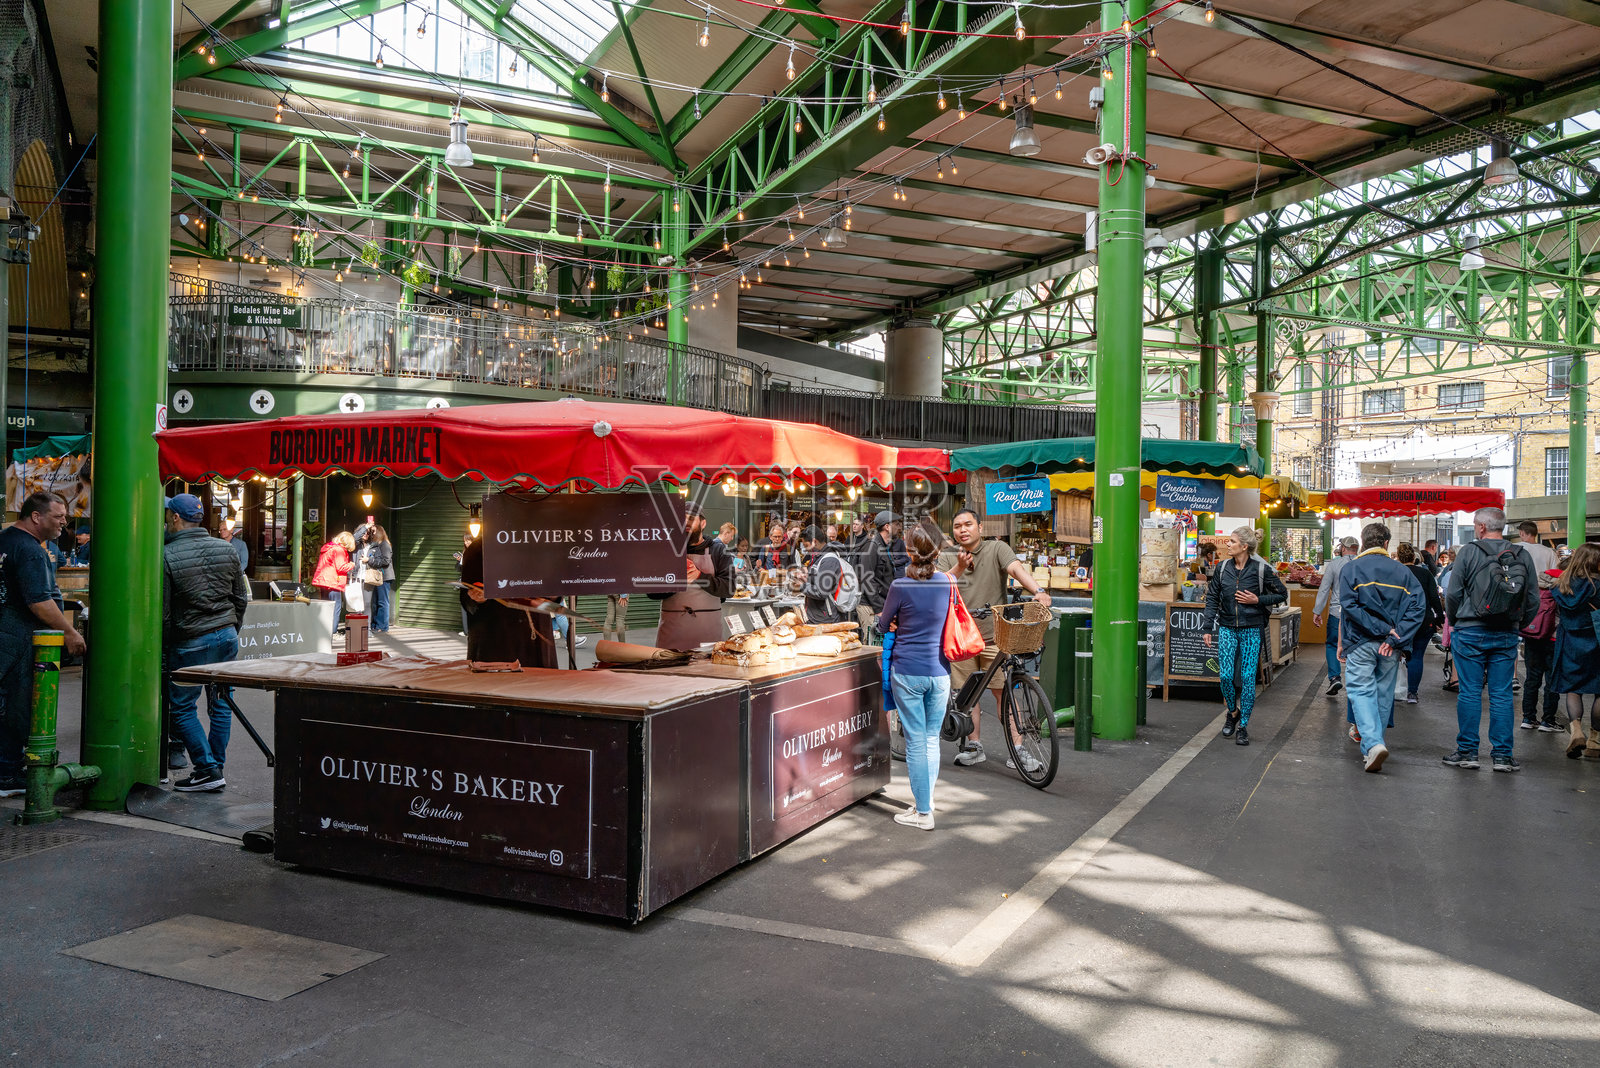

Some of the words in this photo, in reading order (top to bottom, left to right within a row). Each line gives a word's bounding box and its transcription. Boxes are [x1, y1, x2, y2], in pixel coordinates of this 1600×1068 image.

[233, 305, 261, 314] Bedales
[263, 306, 281, 315] Wine
[282, 306, 296, 316] Bar
[246, 315, 253, 324] &
[254, 315, 282, 325] Kitchen
[268, 427, 356, 466] BOROUGH
[358, 426, 443, 465] MARKET
[1160, 481, 1197, 494] Cheddar
[992, 491, 1019, 503] Raw
[1019, 488, 1045, 501] Milk
[1169, 491, 1220, 504] Clothbound
[1379, 490, 1414, 501] BOROUGH
[1415, 490, 1448, 501] MARKET
[1011, 499, 1042, 512] Cheese
[1189, 502, 1213, 510] cheese
[496, 529, 594, 544] OLIVIER'S
[600, 527, 675, 542] BAKERY
[1201, 537, 1230, 547] alpine
[567, 546, 609, 560] London
[560, 577, 616, 585] www.oliviersbakery.com
[1170, 611, 1220, 632] CHEDDR
[264, 632, 304, 646] PASTA
[782, 723, 836, 759] OLIVIER'S
[838, 710, 873, 738] BAKERY
[822, 747, 843, 767] London
[320, 756, 444, 792] OLIVIER'S
[453, 772, 565, 806] BAKERY
[408, 795, 464, 822] London
[402, 832, 469, 848] www.oliviersbakery.com
[503, 846, 549, 861] #oliviersbakery
